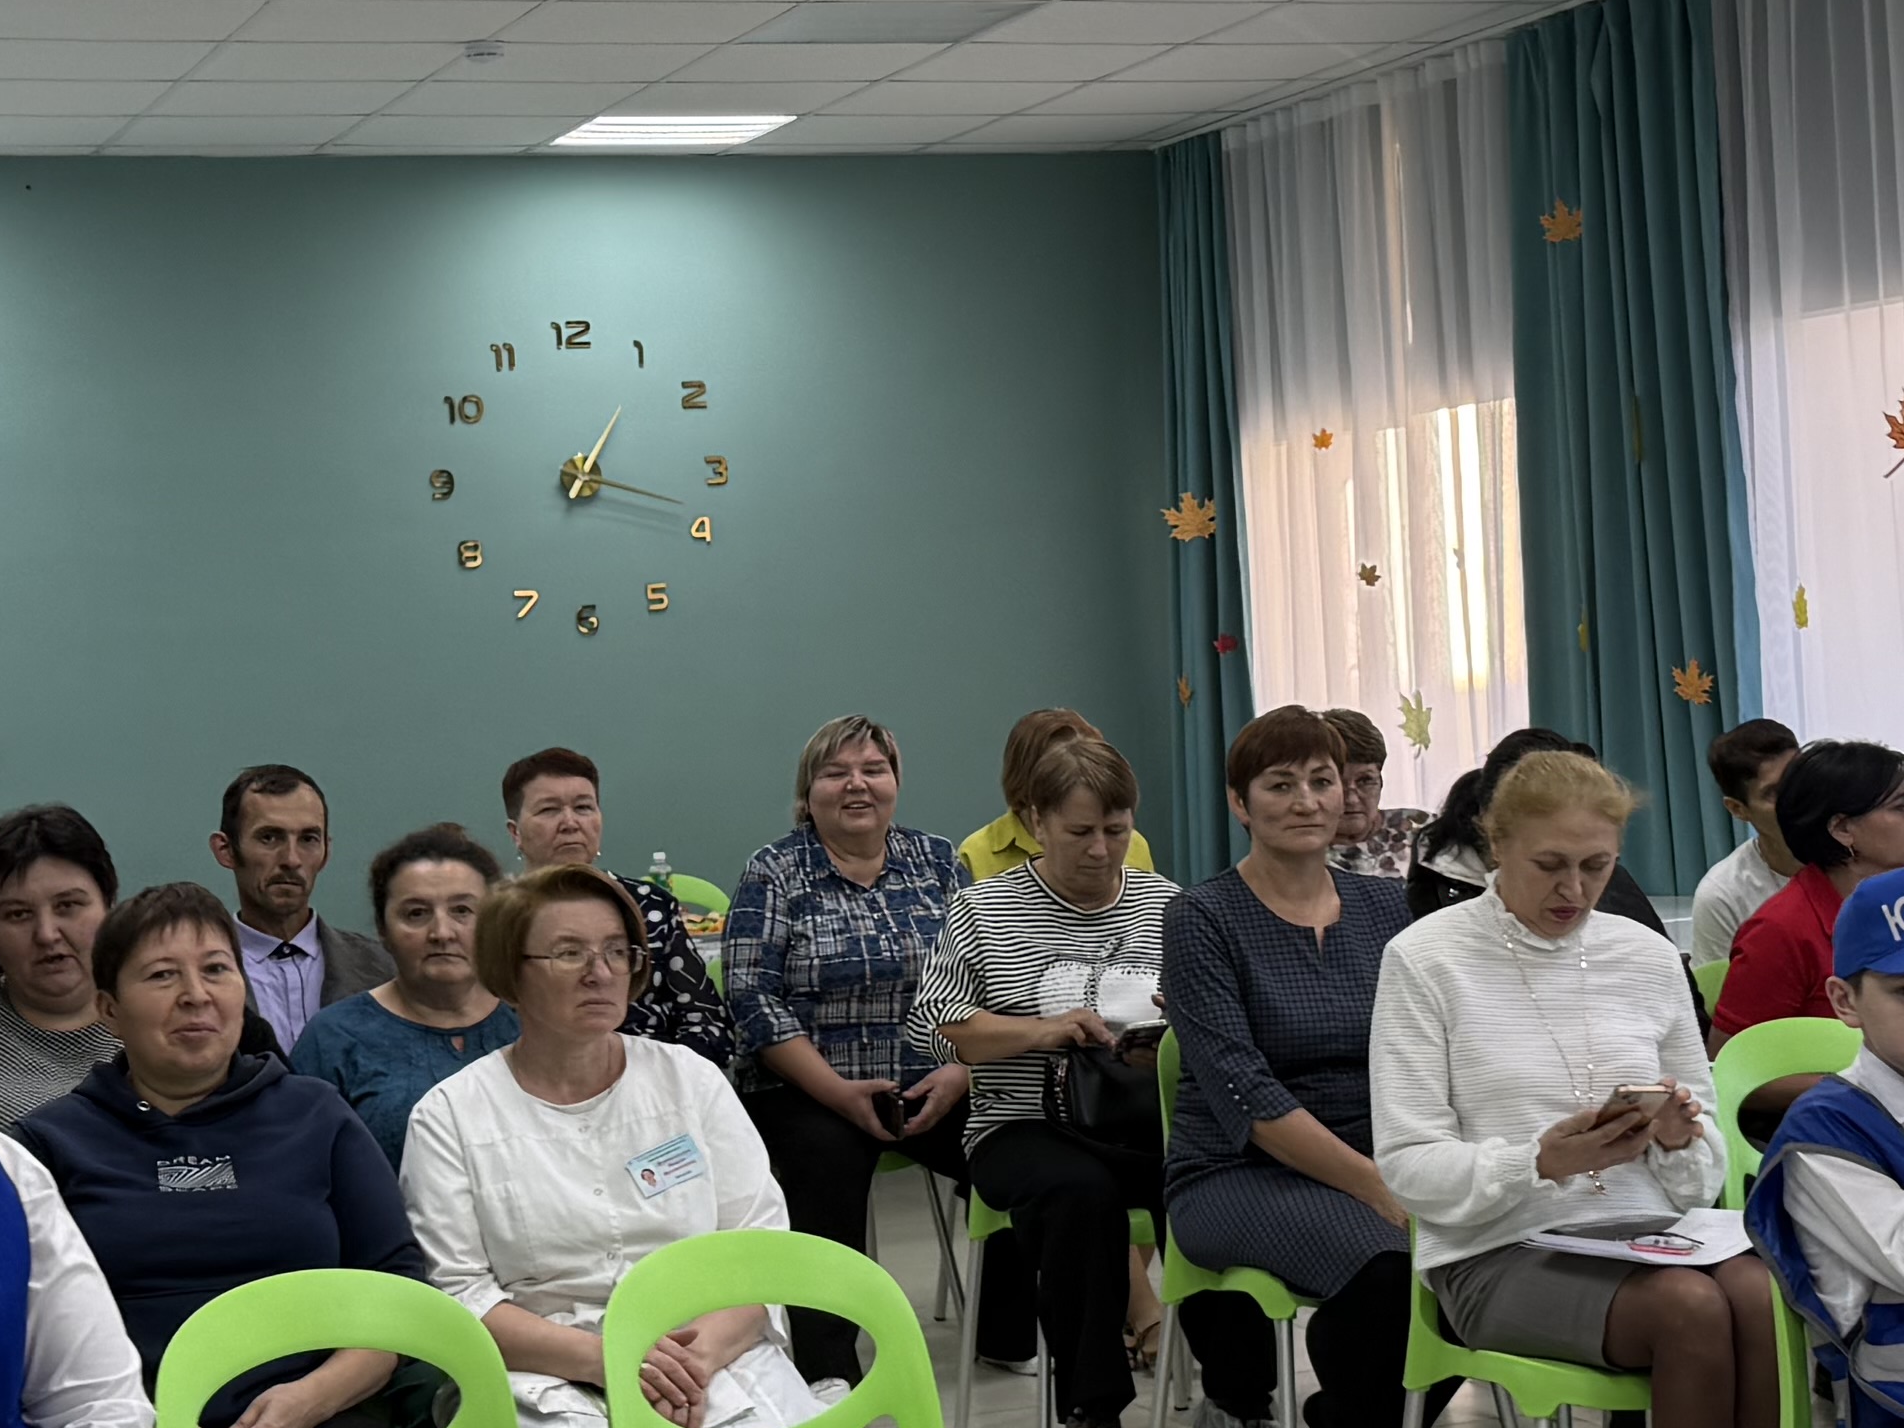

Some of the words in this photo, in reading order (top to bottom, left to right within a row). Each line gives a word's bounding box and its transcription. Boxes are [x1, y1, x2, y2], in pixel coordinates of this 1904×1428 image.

[550, 320, 592, 350] 12
[490, 342, 516, 372] 11
[633, 339, 645, 369] 1
[443, 394, 485, 425] 10
[681, 380, 708, 409] 2
[429, 469, 455, 501] 9
[704, 455, 729, 486] 3
[690, 516, 712, 545] 4
[457, 540, 483, 570] 8
[513, 589, 540, 620] 7
[646, 582, 669, 612] 5
[576, 604, 600, 636] 6
